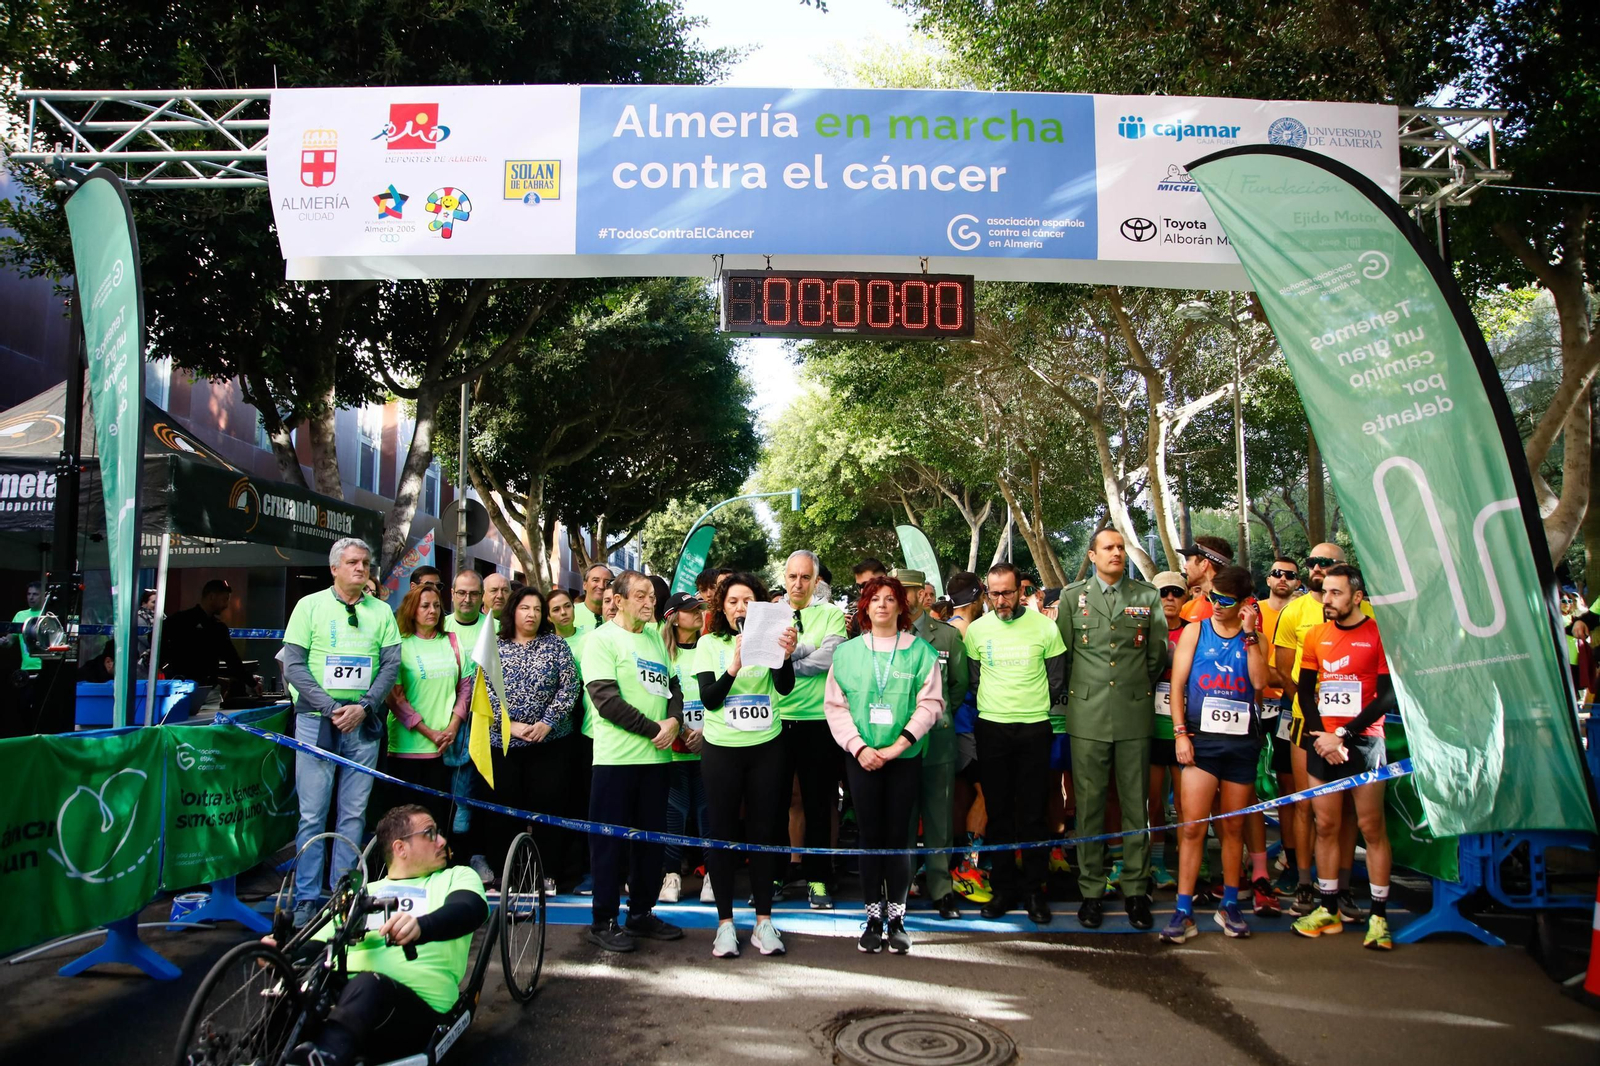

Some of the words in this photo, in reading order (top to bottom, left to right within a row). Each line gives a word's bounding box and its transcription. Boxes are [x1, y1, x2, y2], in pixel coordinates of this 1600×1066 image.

[613, 102, 799, 139] Almería
[814, 112, 871, 139] en
[889, 109, 1065, 144] marcha
[1152, 119, 1241, 142] cajamar
[1307, 126, 1382, 140] UNIVERSIDAD
[1308, 136, 1325, 146] DE
[611, 154, 767, 190] contra
[783, 153, 828, 190] el
[842, 154, 1007, 193] cáncer
[510, 180, 521, 190] DE
[523, 180, 555, 190] CABRAS
[281, 193, 350, 210] ALMERÍA
[298, 212, 335, 222] CIUDAD
[987, 216, 1040, 226] asociación
[1042, 218, 1086, 229] española
[1163, 218, 1207, 230] Toyota
[598, 226, 756, 241] #TodosContraElCáncer
[988, 229, 1020, 237] contra
[1022, 228, 1030, 237] el
[1032, 228, 1066, 238] cáncer
[1164, 233, 1213, 245] Alborán
[988, 240, 1002, 248] en
[1004, 240, 1044, 248] Almería
[263, 493, 353, 535] cruzandolameta
[334, 666, 362, 679] 871
[640, 670, 668, 688] 1545
[1198, 674, 1247, 692] GALO
[1324, 692, 1352, 704] 543
[728, 706, 769, 720] 1600
[1212, 710, 1240, 723] 691
